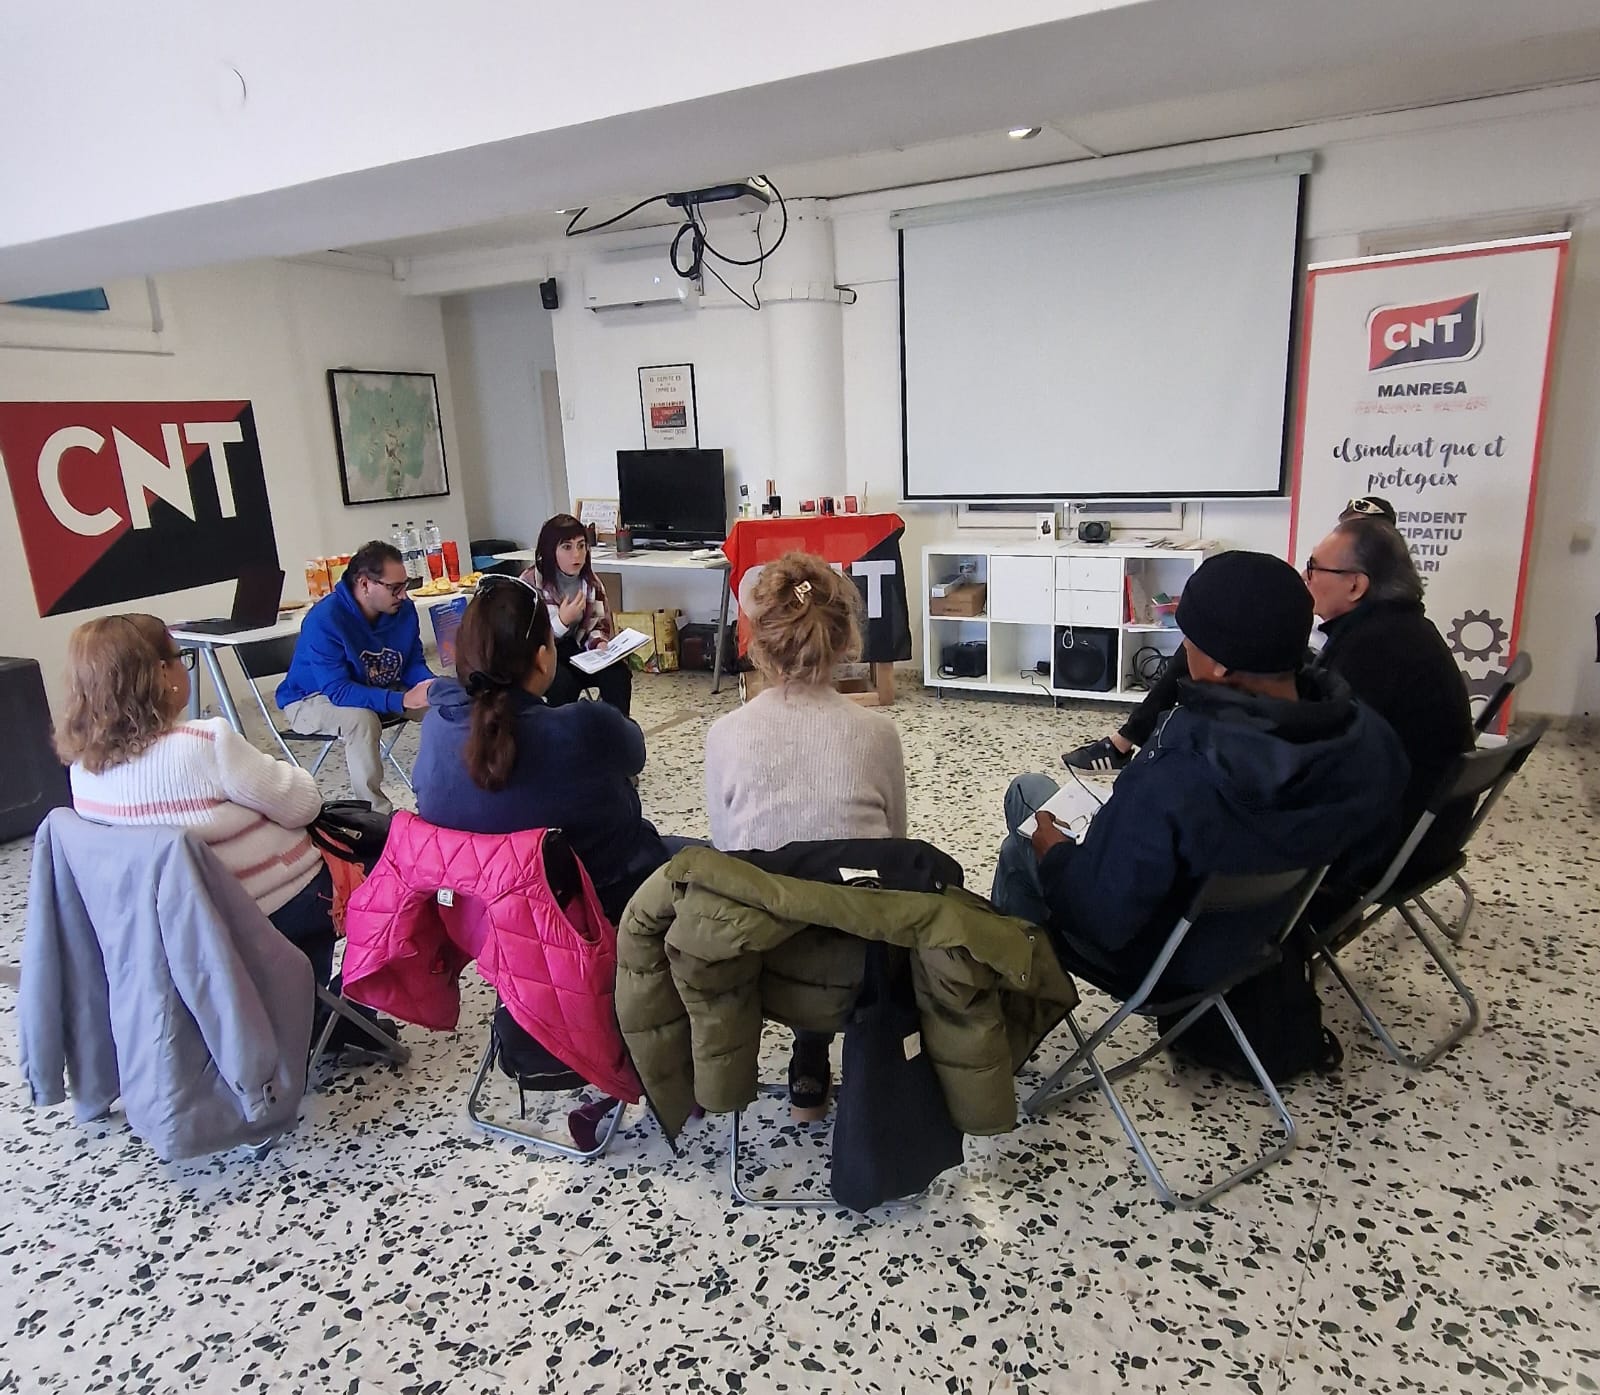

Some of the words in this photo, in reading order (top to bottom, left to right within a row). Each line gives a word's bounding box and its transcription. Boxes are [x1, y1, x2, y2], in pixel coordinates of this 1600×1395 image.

[1384, 312, 1463, 352] CNT
[1378, 381, 1467, 397] MANRESA
[1333, 437, 1351, 462] el
[1350, 434, 1434, 462] sindicat
[1440, 442, 1478, 467] que
[1485, 435, 1505, 458] et
[37, 421, 244, 537] CNT
[1367, 467, 1458, 494] protegeix
[1397, 511, 1467, 524] ENDENT
[1399, 527, 1462, 540] CIPATIU
[1409, 543, 1448, 556] ATIU
